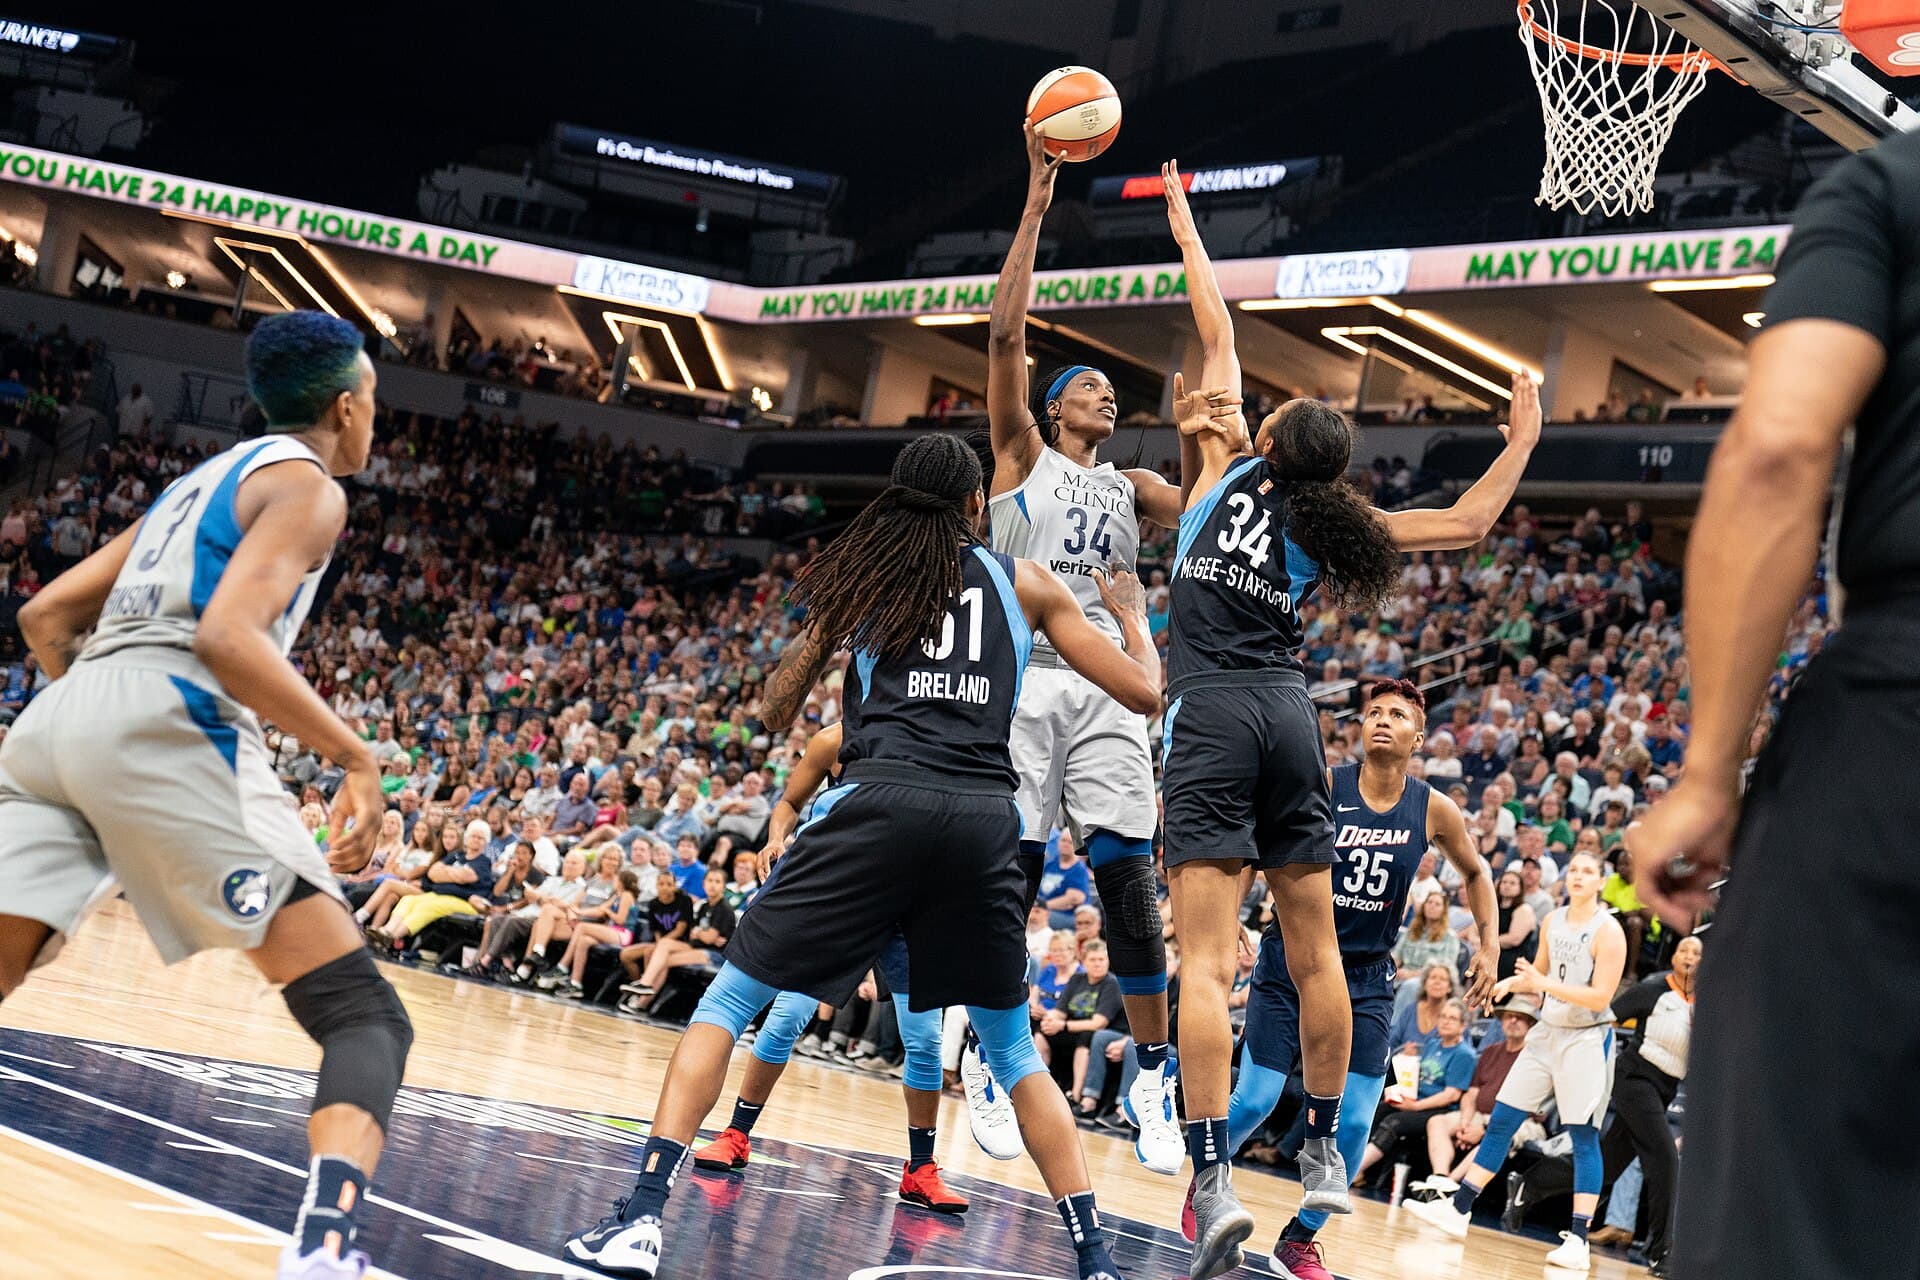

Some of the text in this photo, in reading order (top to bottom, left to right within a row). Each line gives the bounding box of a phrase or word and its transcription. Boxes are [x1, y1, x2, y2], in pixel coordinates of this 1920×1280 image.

[65, 163, 142, 198] HAVE
[150, 181, 185, 206] 24
[193, 188, 290, 226] HAPPY
[297, 209, 402, 249] HOURS
[409, 231, 428, 254] A
[439, 235, 499, 266] DAY
[1466, 235, 1777, 282] MAY YOU HAVE 24
[760, 271, 1188, 317] MAY YOU HAVE 24 HAP HOURS A DA
[1639, 445, 1673, 467] 110
[1053, 486, 1129, 518] CLINIC
[1063, 507, 1112, 561] 34
[1217, 492, 1273, 570] 34
[907, 671, 990, 705] BRELAND
[1335, 824, 1411, 848] DREAM
[1343, 848, 1394, 897] 35
